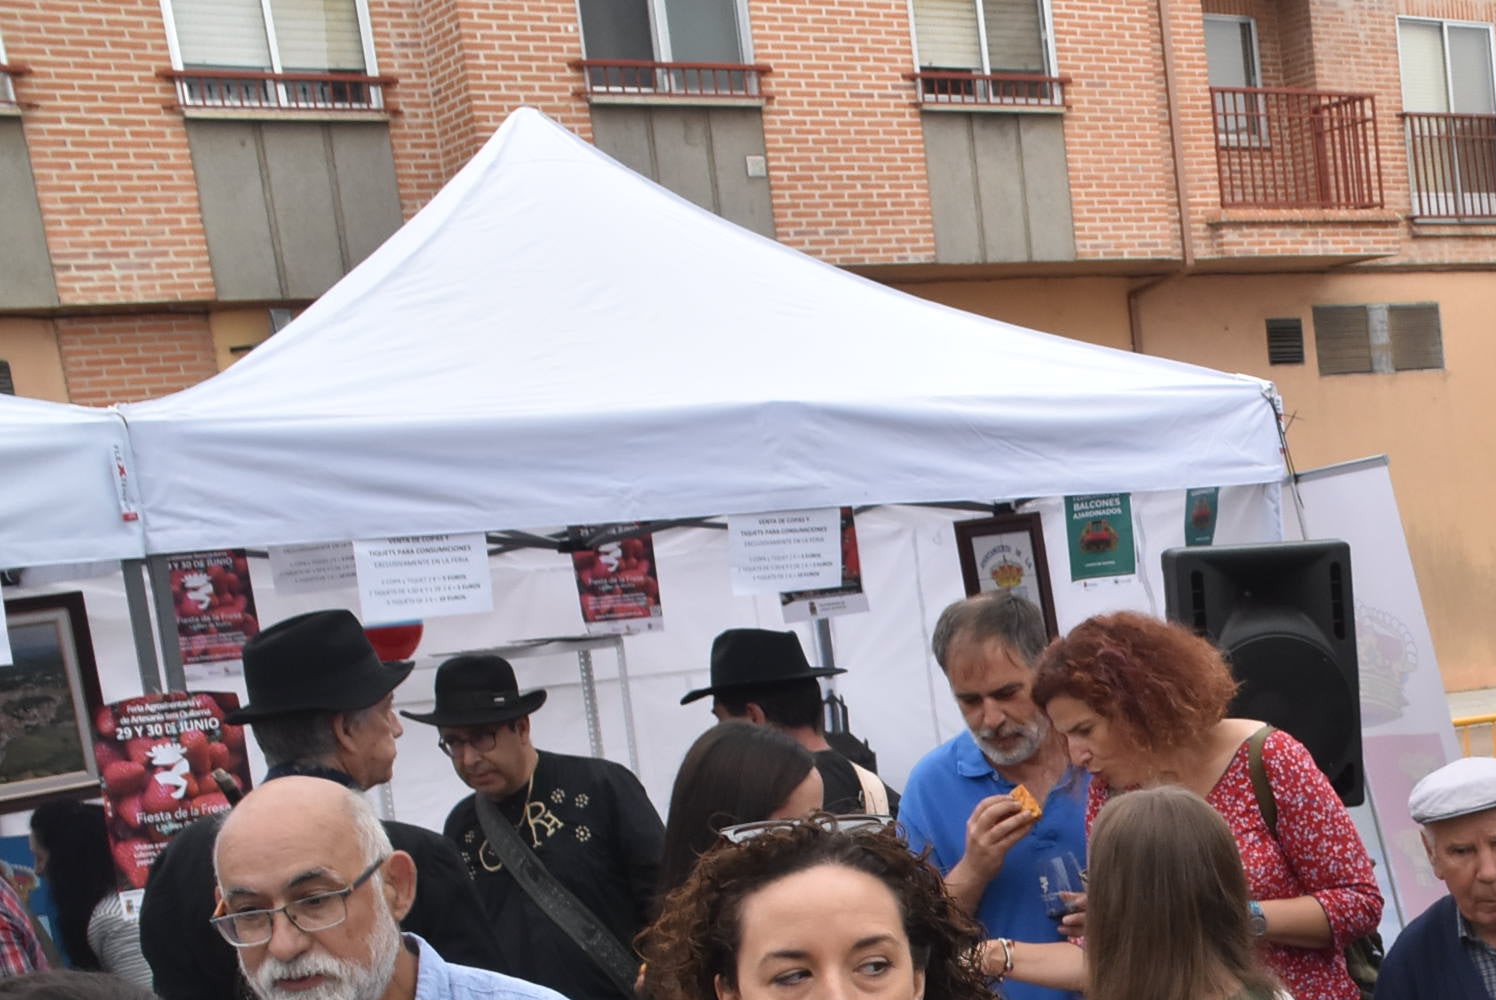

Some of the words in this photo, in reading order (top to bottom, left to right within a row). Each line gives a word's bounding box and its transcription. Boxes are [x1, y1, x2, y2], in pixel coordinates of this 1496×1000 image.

[1073, 498, 1120, 511] BALCONES
[1073, 507, 1122, 520] AJARDINADOS
[115, 726, 133, 741] 29
[134, 726, 145, 738] Y
[148, 724, 163, 736] 30
[178, 717, 220, 732] JUNIO
[135, 811, 172, 825] Fiesta
[174, 807, 188, 820] de
[190, 806, 200, 817] la
